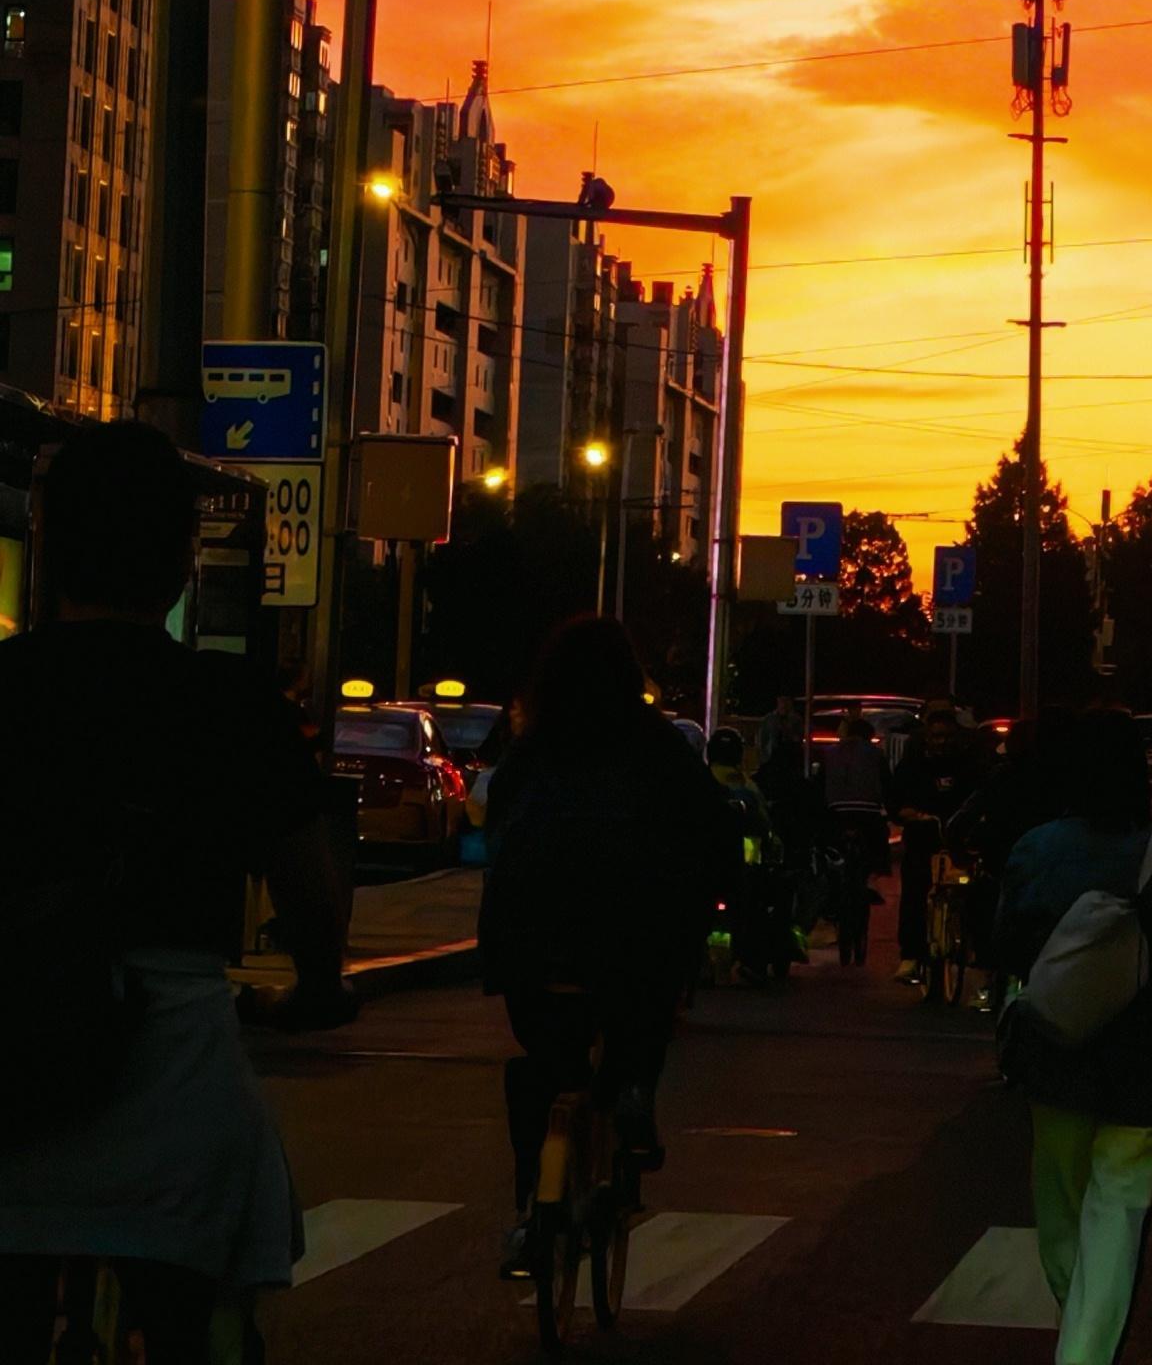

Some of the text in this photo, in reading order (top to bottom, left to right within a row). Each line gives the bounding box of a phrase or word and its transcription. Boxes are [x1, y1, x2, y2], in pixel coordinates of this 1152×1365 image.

[269, 479, 311, 514] :00
[269, 520, 310, 556] :00
[795, 516, 827, 561] P
[941, 556, 965, 591] P
